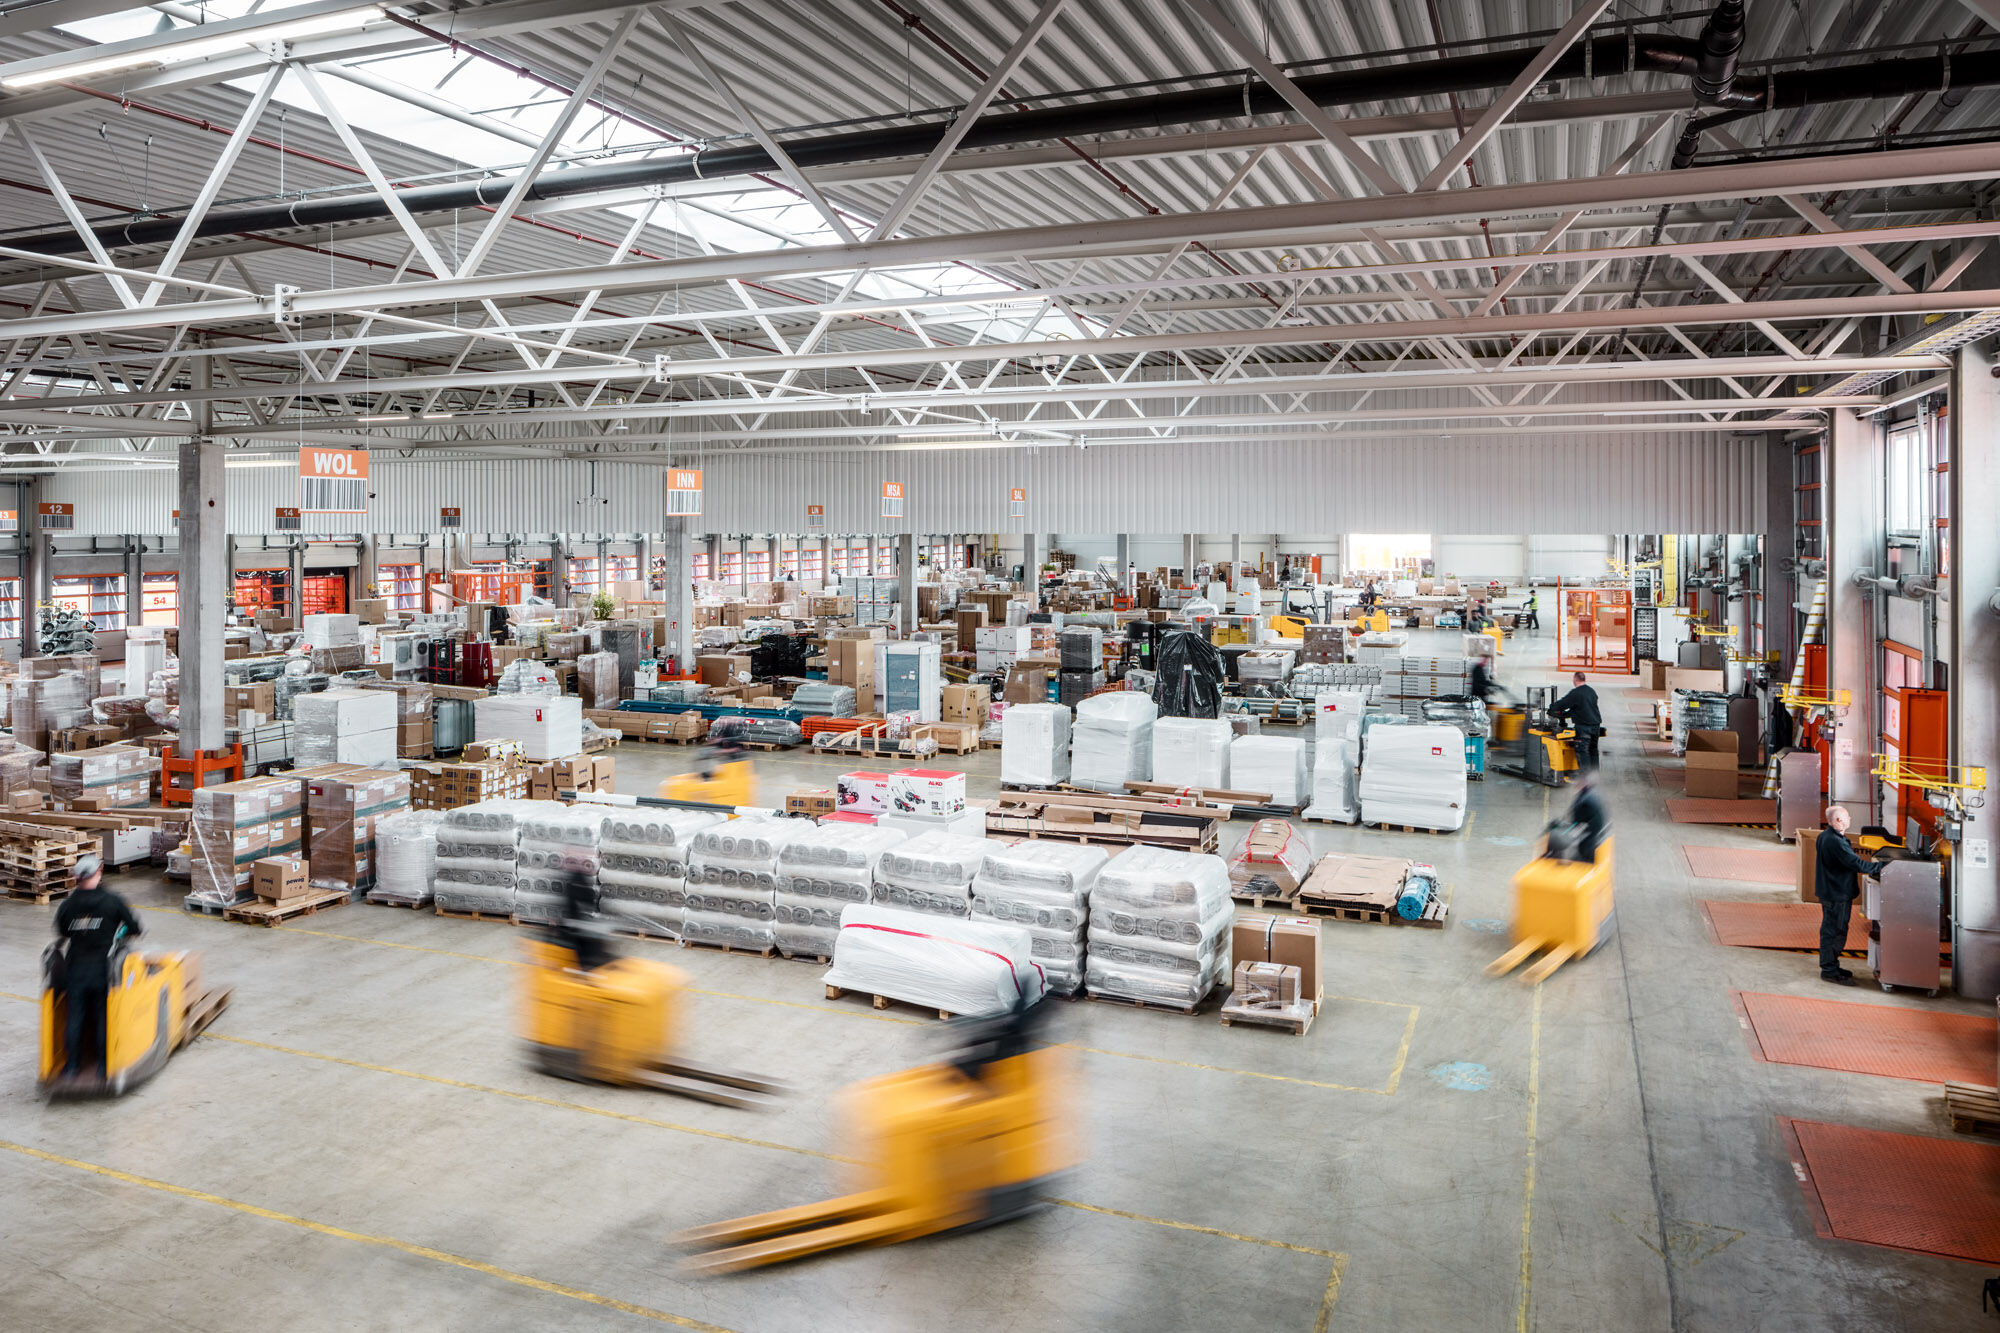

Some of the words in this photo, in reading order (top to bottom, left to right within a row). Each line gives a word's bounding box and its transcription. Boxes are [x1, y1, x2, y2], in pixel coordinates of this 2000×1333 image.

[313, 452, 358, 475] WOL
[676, 472, 695, 488] INN
[49, 504, 63, 514] 12
[283, 508, 294, 517] 14
[153, 596, 166, 605] 54
[64, 601, 78, 610] 55
